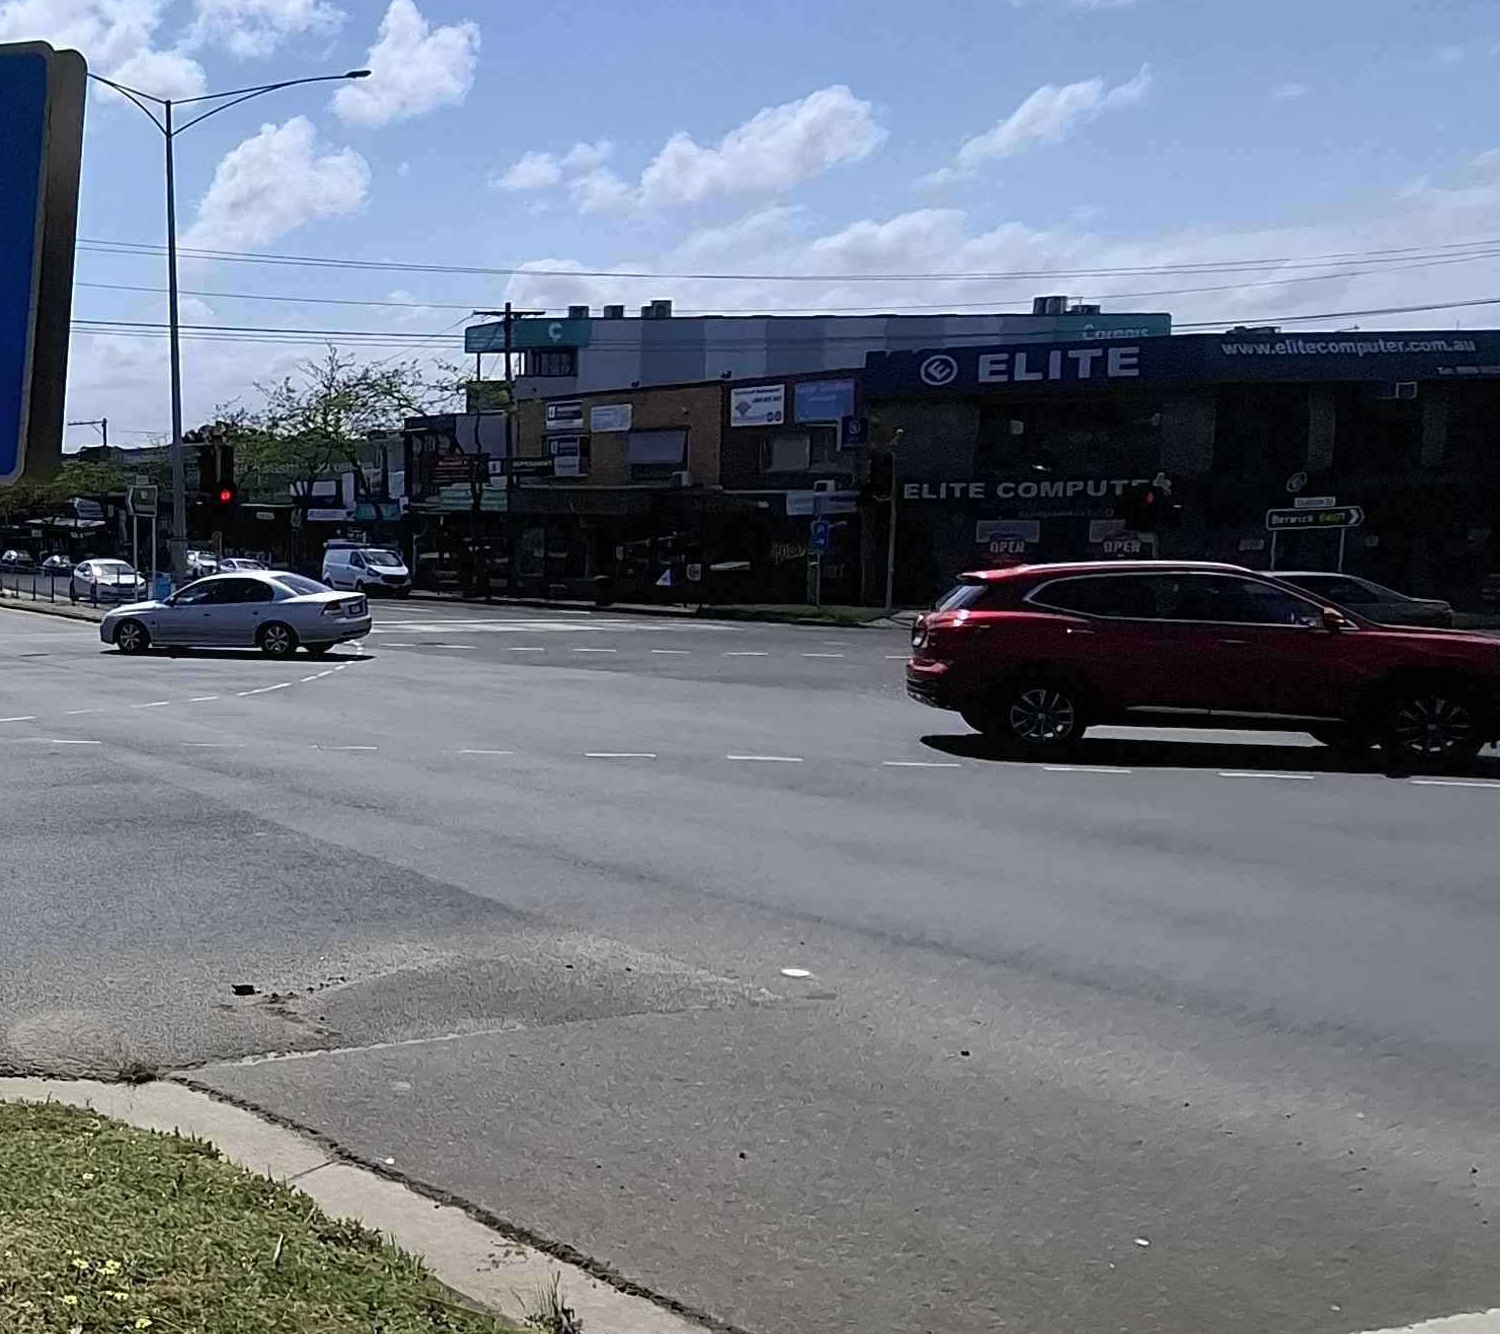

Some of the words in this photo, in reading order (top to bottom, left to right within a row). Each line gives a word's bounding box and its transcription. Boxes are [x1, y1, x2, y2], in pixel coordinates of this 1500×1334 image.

[1221, 338, 1476, 357] www.elitecomputer.com.au
[978, 347, 1140, 383] ELITE
[903, 482, 986, 499] ELITE
